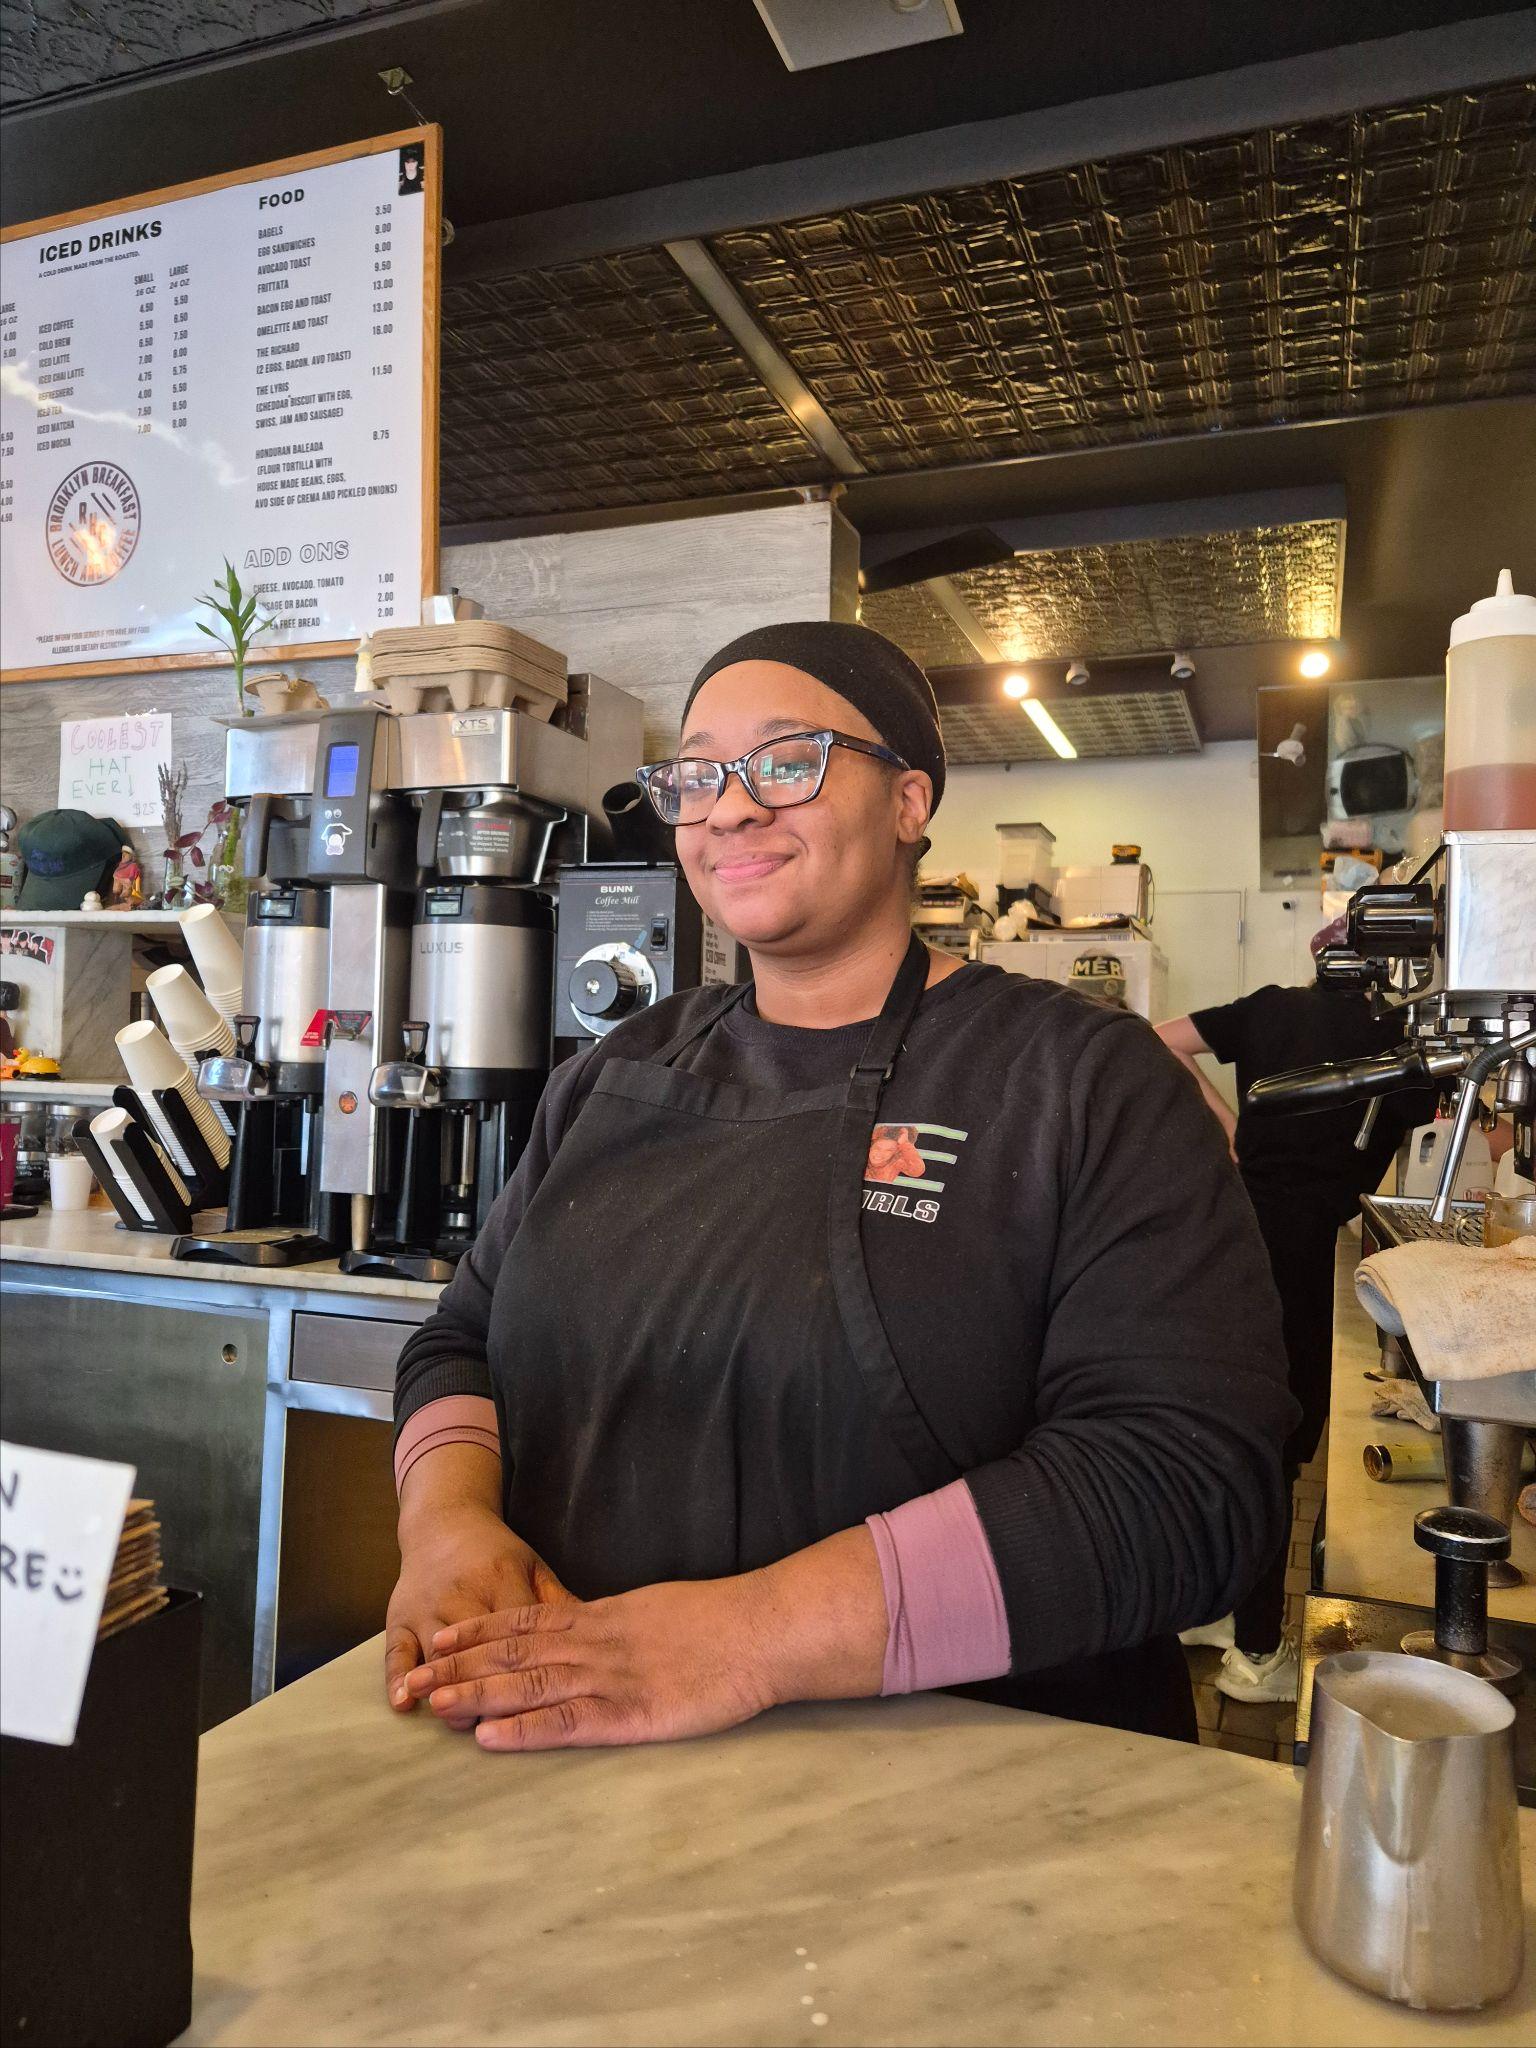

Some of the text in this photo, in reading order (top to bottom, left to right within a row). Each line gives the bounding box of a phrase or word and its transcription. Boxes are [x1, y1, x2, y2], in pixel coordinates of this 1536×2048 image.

[259, 189, 304, 209] FOOD
[375, 204, 392, 215] 3.50
[258, 225, 283, 239] BAGELS
[375, 223, 391, 234] 9.00
[40, 220, 162, 264] ICED DRINKS
[257, 237, 315, 257] EGG SANDWICHES
[374, 241, 391, 252] 9.00
[169, 264, 189, 276] LARGE
[257, 256, 311, 275] AVOCADO TOAST
[374, 260, 391, 271] 9.50
[134, 273, 154, 285] SMALL
[372, 278, 393, 290] 13.00
[257, 279, 289, 294] FRITTATA
[174, 294, 188, 305] 5.50
[257, 293, 331, 315] BACON EGG AND TOAST
[372, 301, 393, 312] 13.00
[39, 319, 74, 334] ICED COFFEE
[256, 315, 328, 336] OMELETTE AND TOAST
[372, 323, 393, 335] 16.00
[54, 336, 71, 348] BREW
[173, 329, 188, 341] 7.50
[256, 342, 300, 357] THE RICHARD
[39, 354, 70, 368] ICED LATTE
[311, 354, 325, 365] AVO
[39, 374, 52, 384] ICED
[67, 367, 85, 379] LATTE
[172, 364, 187, 375] 5.75
[372, 364, 392, 376] 11.50
[38, 386, 74, 401] REFRESHERS
[256, 385, 268, 395] THE
[290, 394, 316, 407] BISCUIT
[317, 391, 335, 403] WITH
[279, 415, 292, 425] JAM
[294, 412, 308, 422] AND
[309, 407, 344, 420] SAUSAGE)
[37, 420, 74, 435] ICED MATCHA
[372, 429, 390, 440] 8.75
[37, 437, 71, 451] ICED MOCHA
[255, 441, 324, 459] HONDURAN BALEADA
[257, 457, 333, 476] (FLOUR TORTILLA WITH
[256, 481, 279, 492] HOUSE
[280, 478, 299, 489] MADE
[92, 466, 137, 520] BREAKFAST
[269, 496, 285, 507] SIDE
[286, 495, 295, 505] OF
[297, 492, 320, 504] CREMA
[321, 490, 336, 501] AND
[337, 487, 366, 499] PICKLED
[367, 484, 397, 496] ONIONS)
[49, 470, 89, 533] BROOKLYN
[52, 538, 79, 577] LUNCH
[243, 540, 349, 569] ADD ONS
[317, 576, 344, 588] TOMATO
[379, 573, 394, 583] 1.00
[284, 598, 318, 610] OR BACON
[377, 592, 394, 602] 2.00
[377, 607, 394, 617] 2.00
[280, 618, 296, 630] FREE
[298, 617, 320, 628] BREAD
[459, 718, 489, 730] XTS
[70, 721, 164, 756] COOLEST
[88, 755, 132, 779] HAT
[132, 802, 157, 817] $25
[600, 885, 633, 893] BUNN
[595, 895, 640, 908] Coffee Mill
[420, 942, 464, 954] LUXUS
